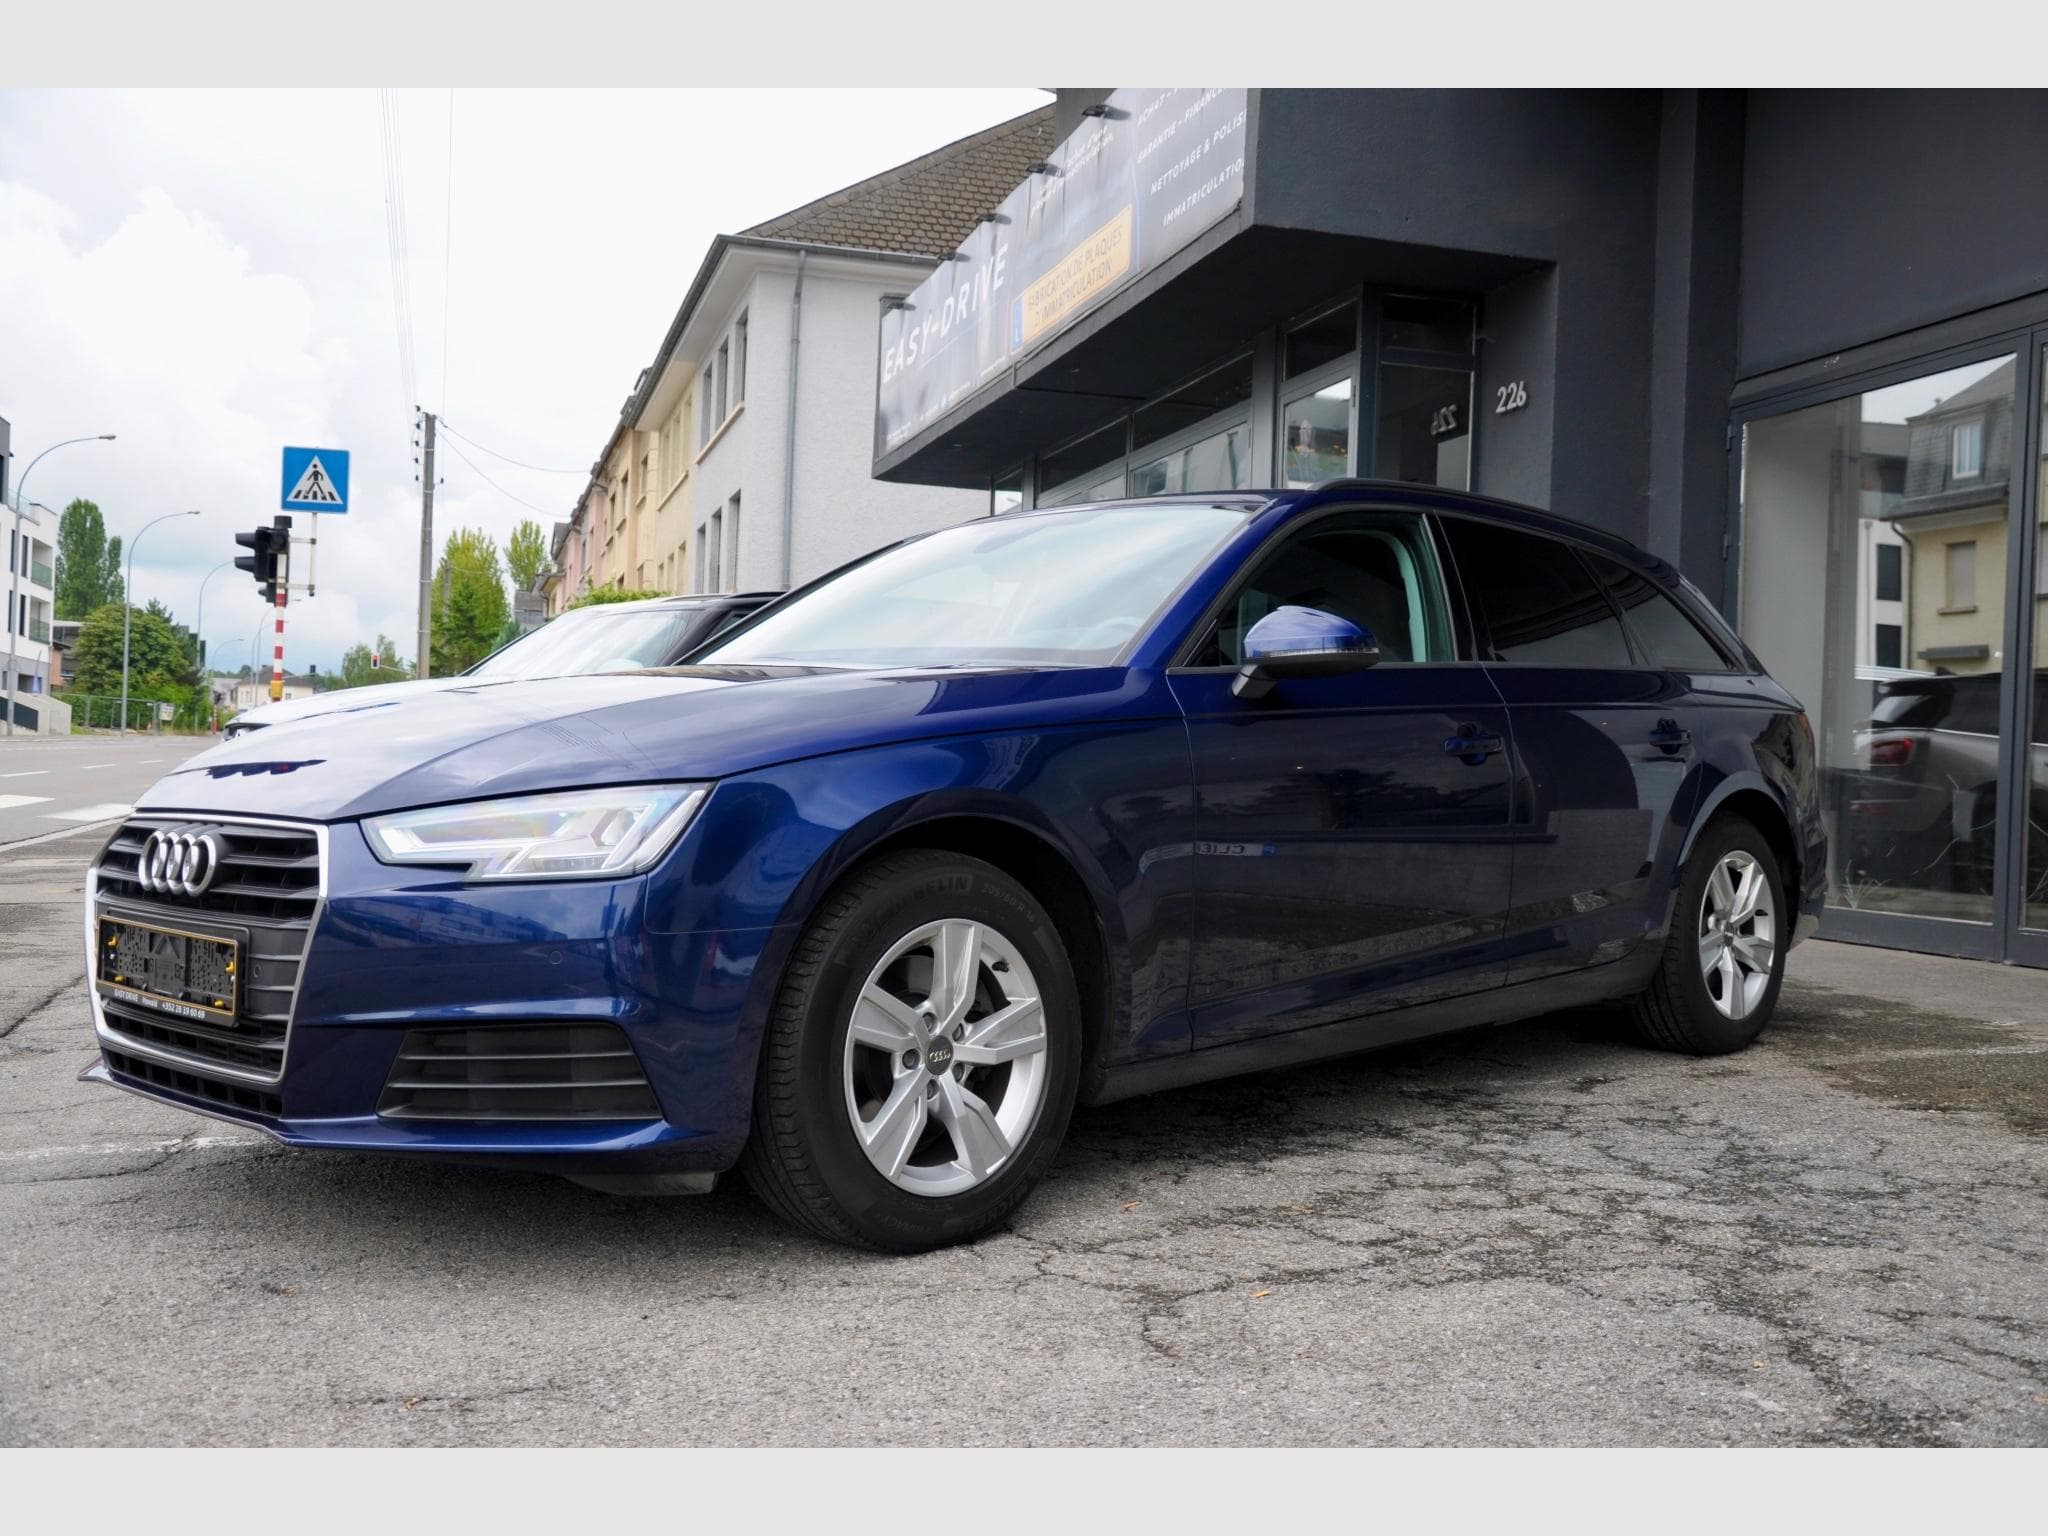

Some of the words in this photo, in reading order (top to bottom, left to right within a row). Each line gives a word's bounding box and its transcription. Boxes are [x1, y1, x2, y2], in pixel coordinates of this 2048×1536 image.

[1137, 121, 1177, 163] GARANTIE
[1150, 144, 1202, 196] NETTOYAGE
[1204, 138, 1211, 153] &
[1162, 157, 1244, 227] IMMATRICULATIO
[1028, 264, 1072, 311] FABRICATION
[1073, 255, 1083, 277] DE
[1085, 224, 1122, 266] PLAQUES
[883, 243, 1009, 384] EASY-DRIVE
[1496, 381, 1527, 413] 226
